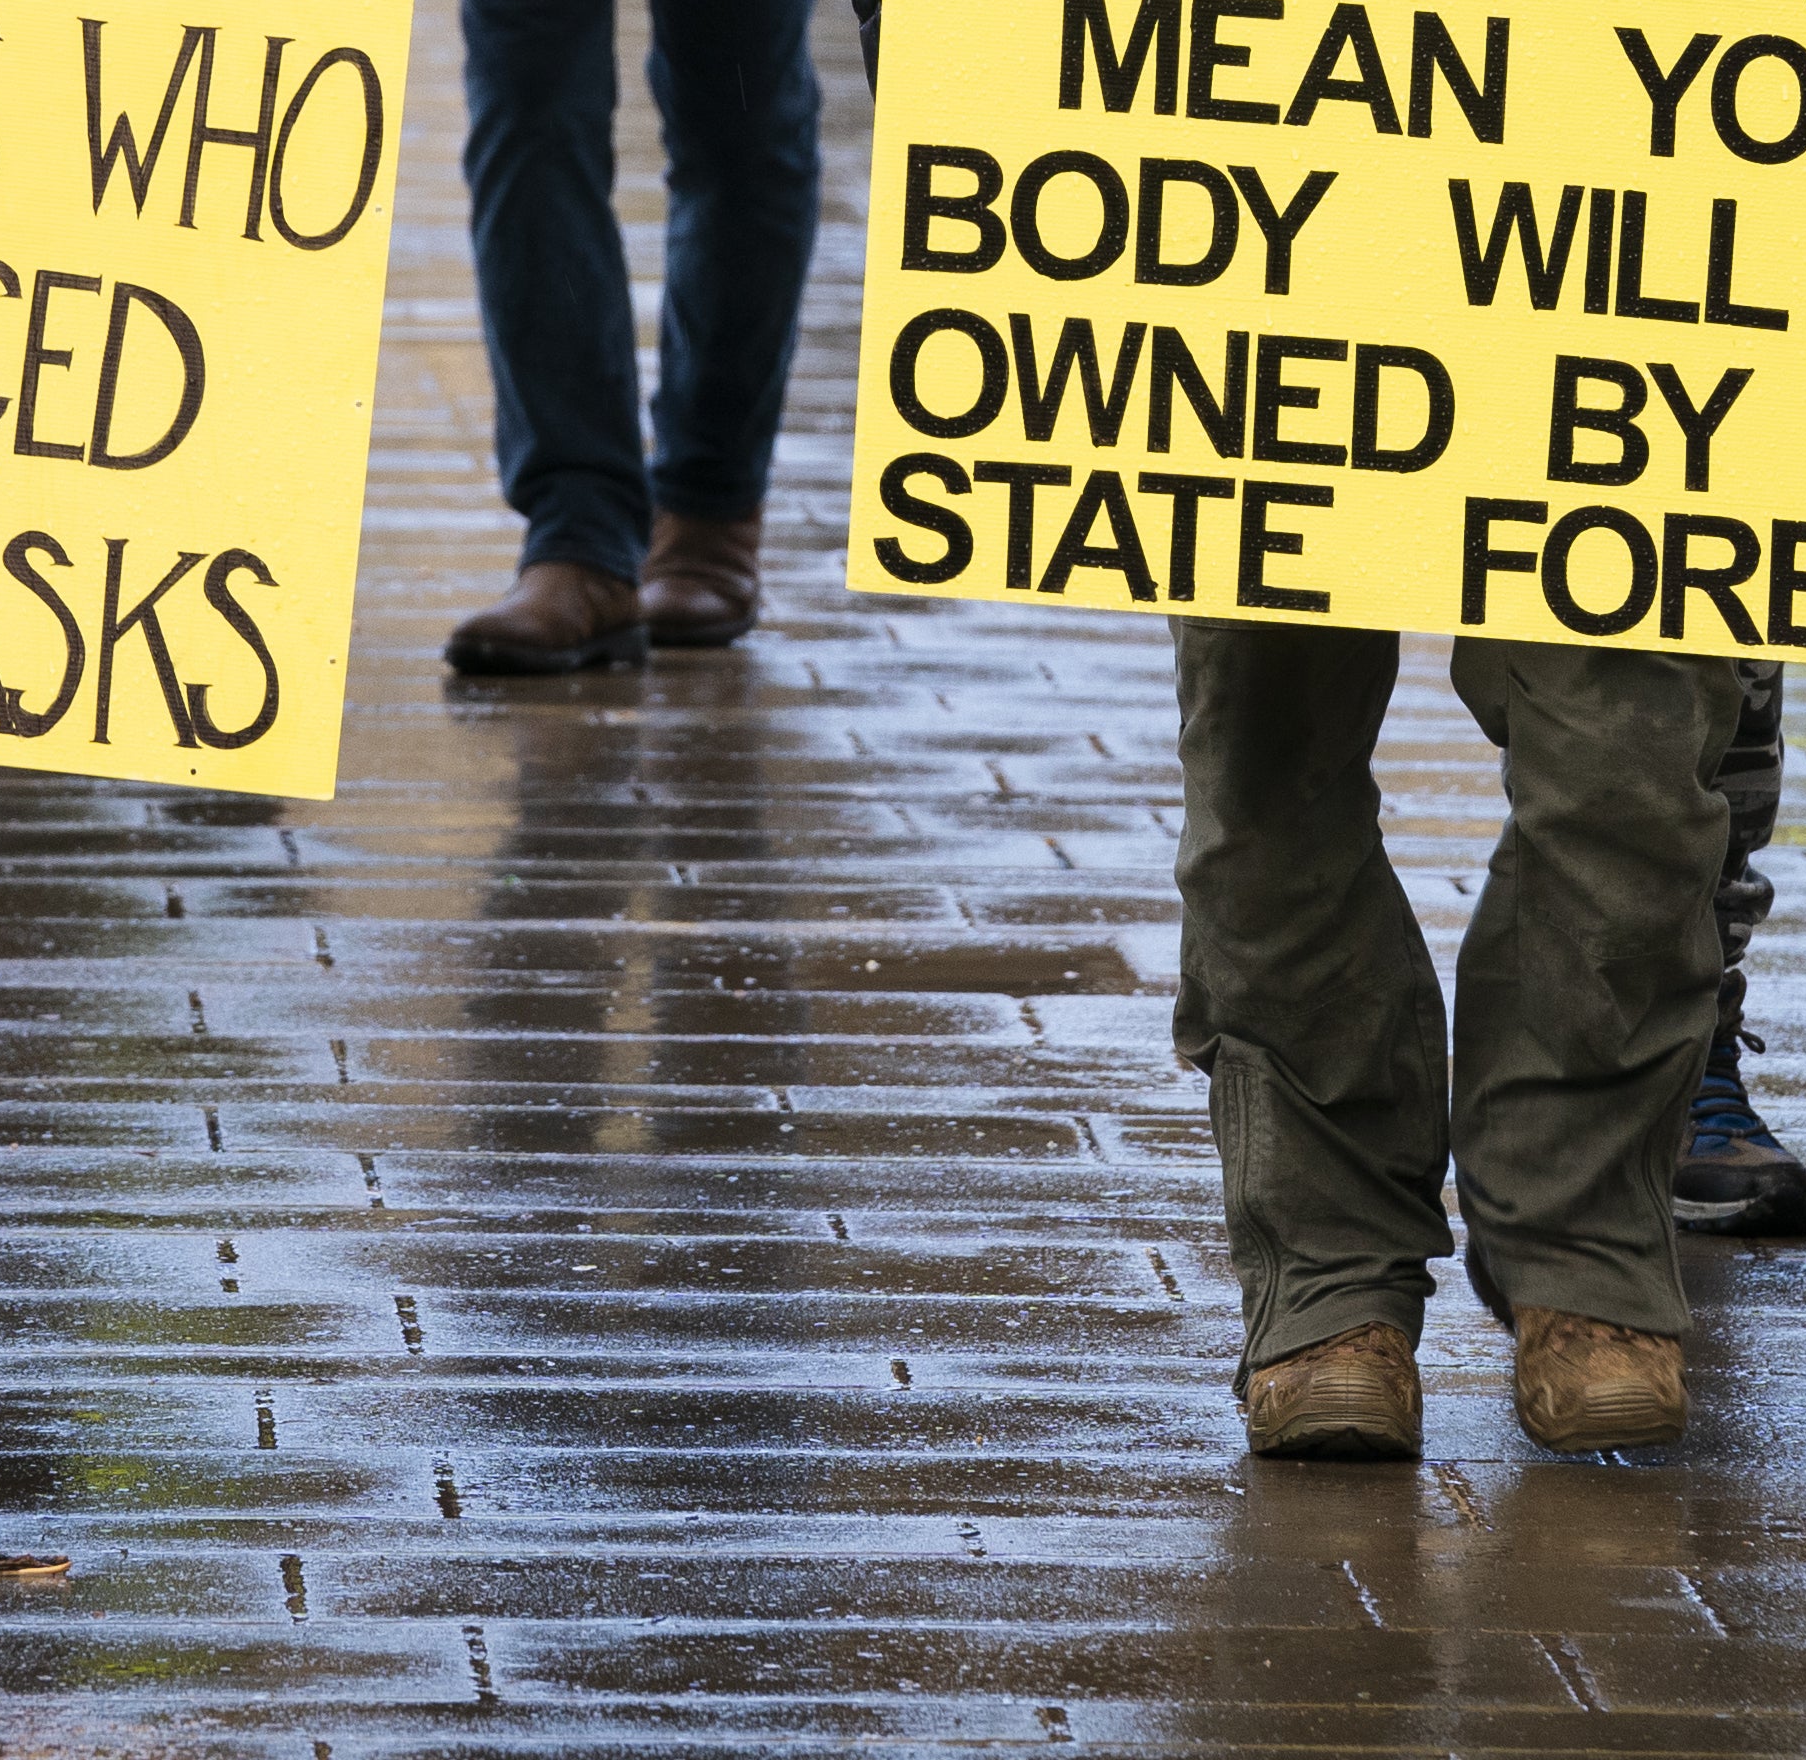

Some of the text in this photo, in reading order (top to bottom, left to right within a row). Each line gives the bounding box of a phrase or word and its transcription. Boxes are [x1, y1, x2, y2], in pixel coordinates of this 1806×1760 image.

[78, 18, 383, 250] WHO
[901, 144, 1339, 295] BODY
[1448, 179, 1789, 331] WILL
[890, 308, 1455, 474] OWNED
[1547, 355, 1754, 492] BY
[874, 453, 1334, 613] STATE
